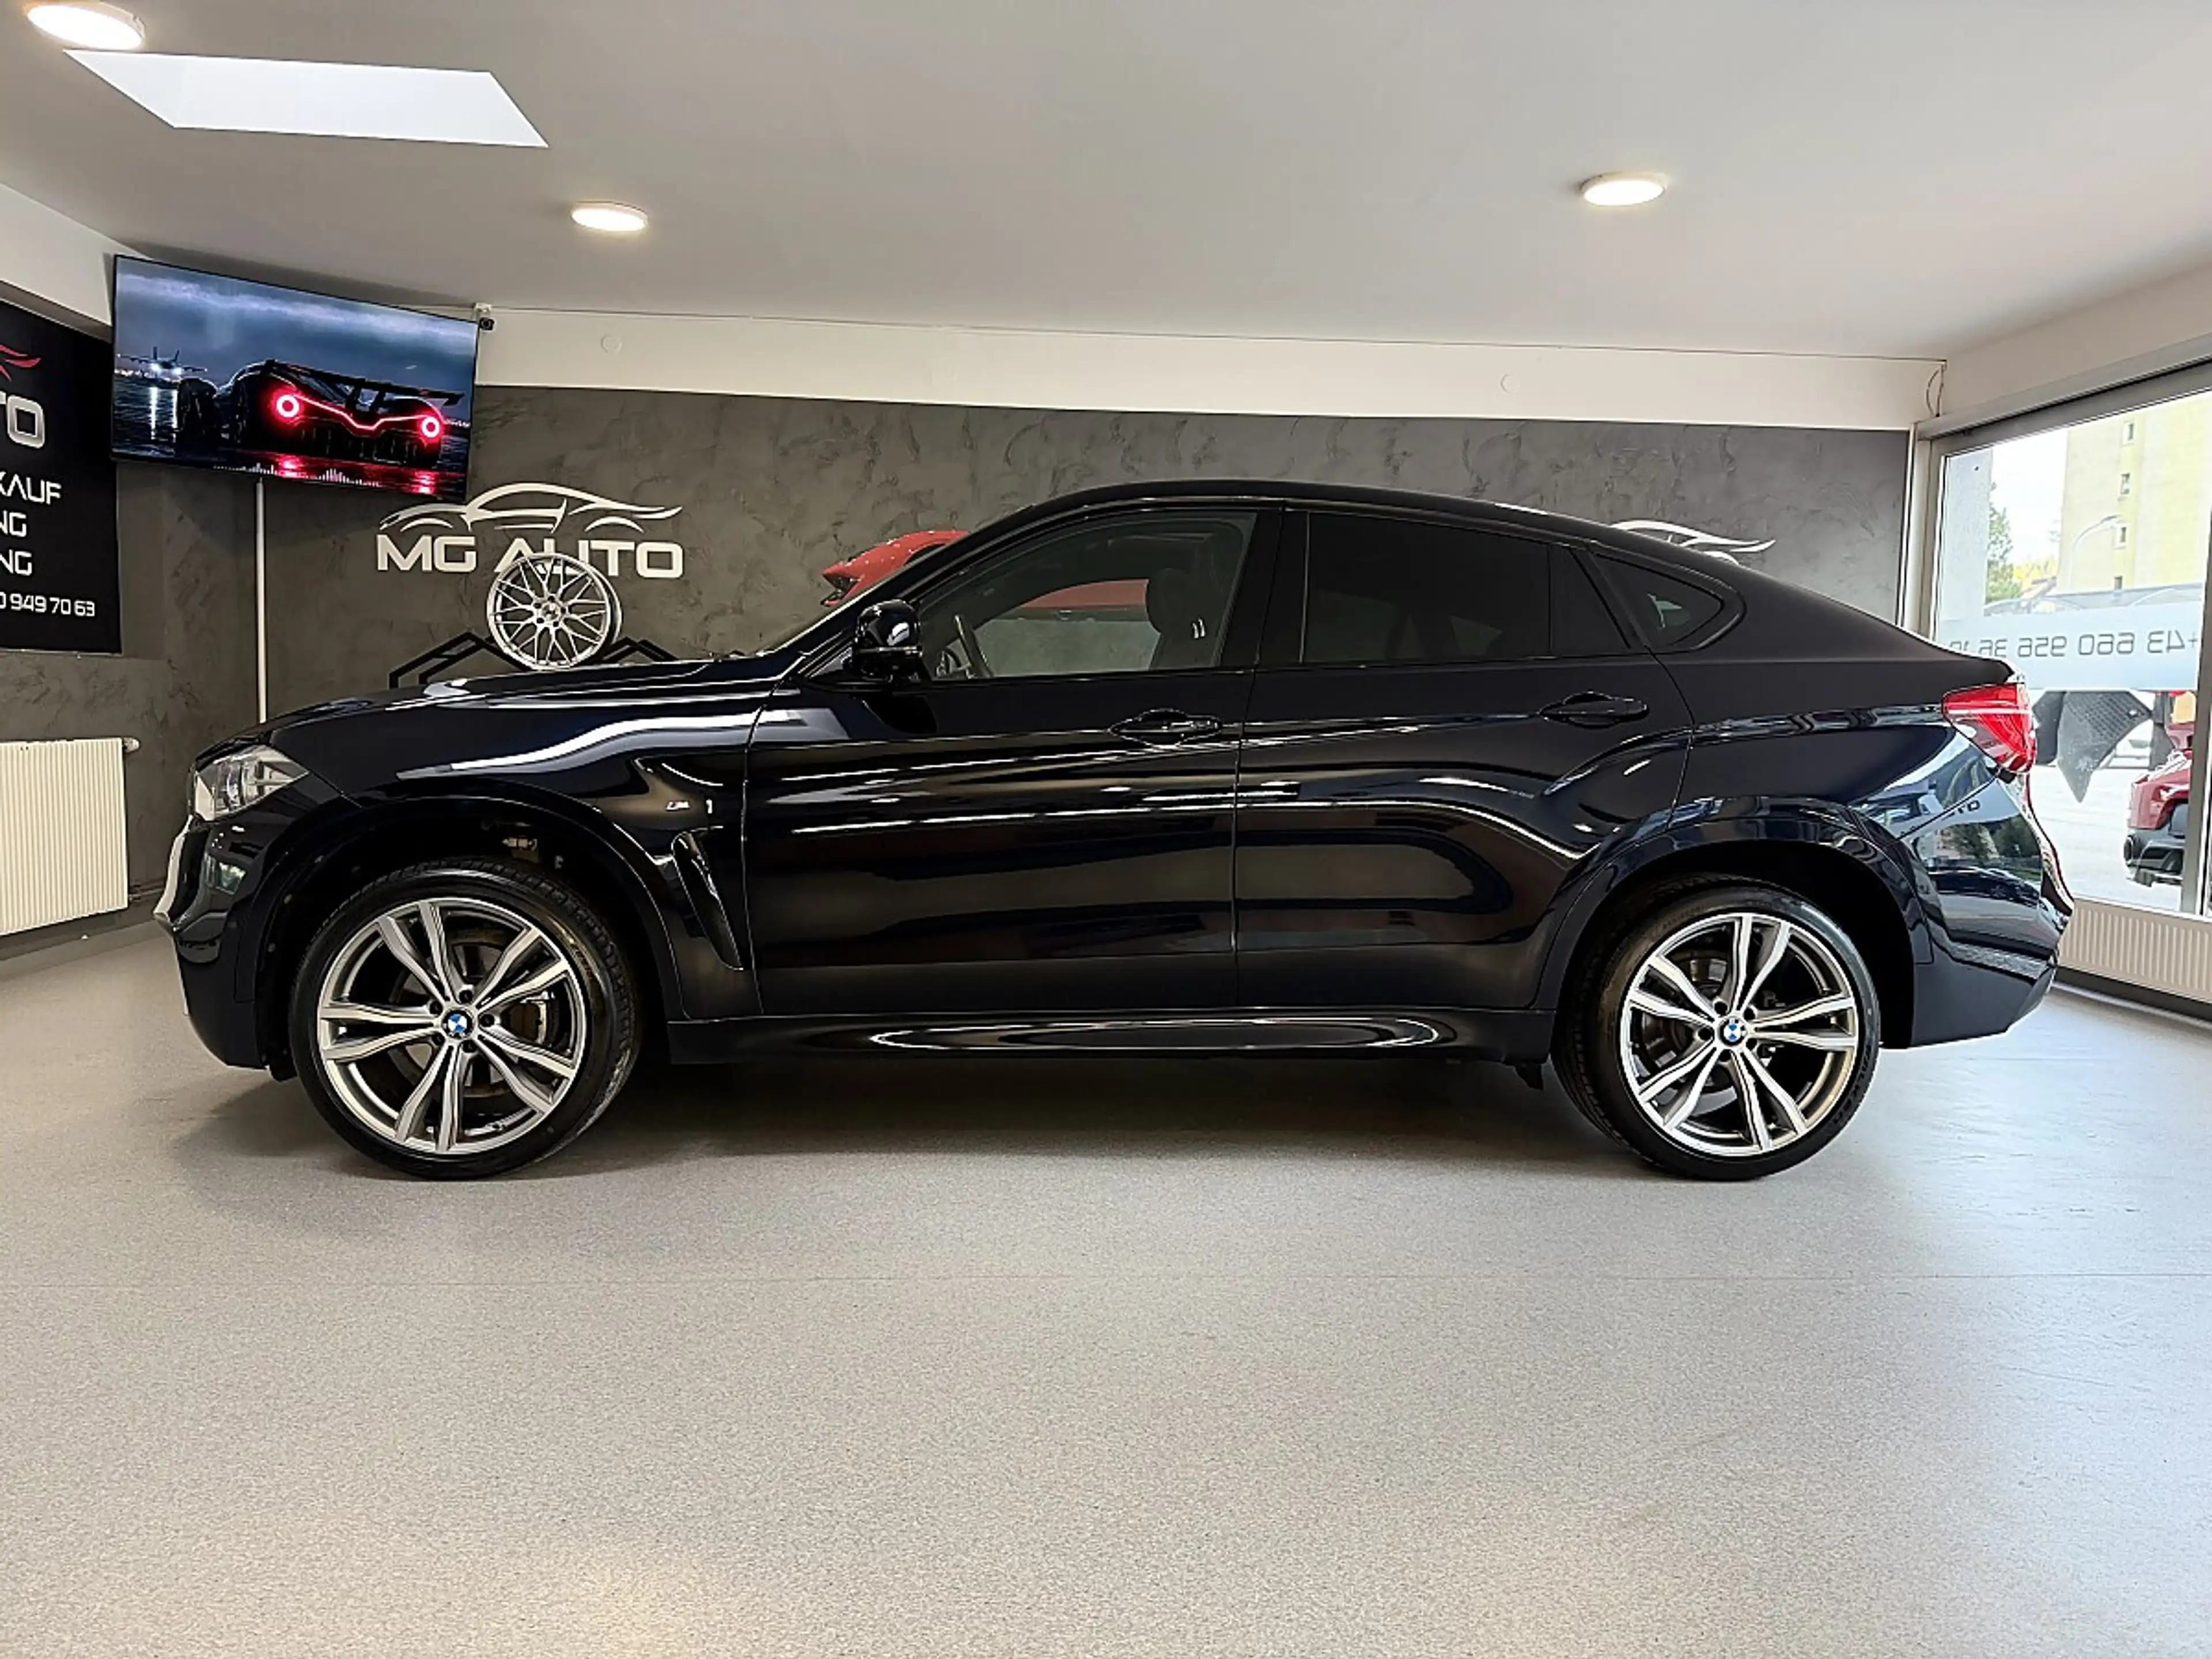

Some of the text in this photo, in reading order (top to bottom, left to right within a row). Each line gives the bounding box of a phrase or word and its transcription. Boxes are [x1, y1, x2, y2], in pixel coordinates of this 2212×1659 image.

[0, 391, 45, 449] O
[377, 534, 683, 578] MG AUTO
[10, 593, 47, 613] 949
[50, 597, 71, 615] 70
[74, 600, 95, 616] 63
